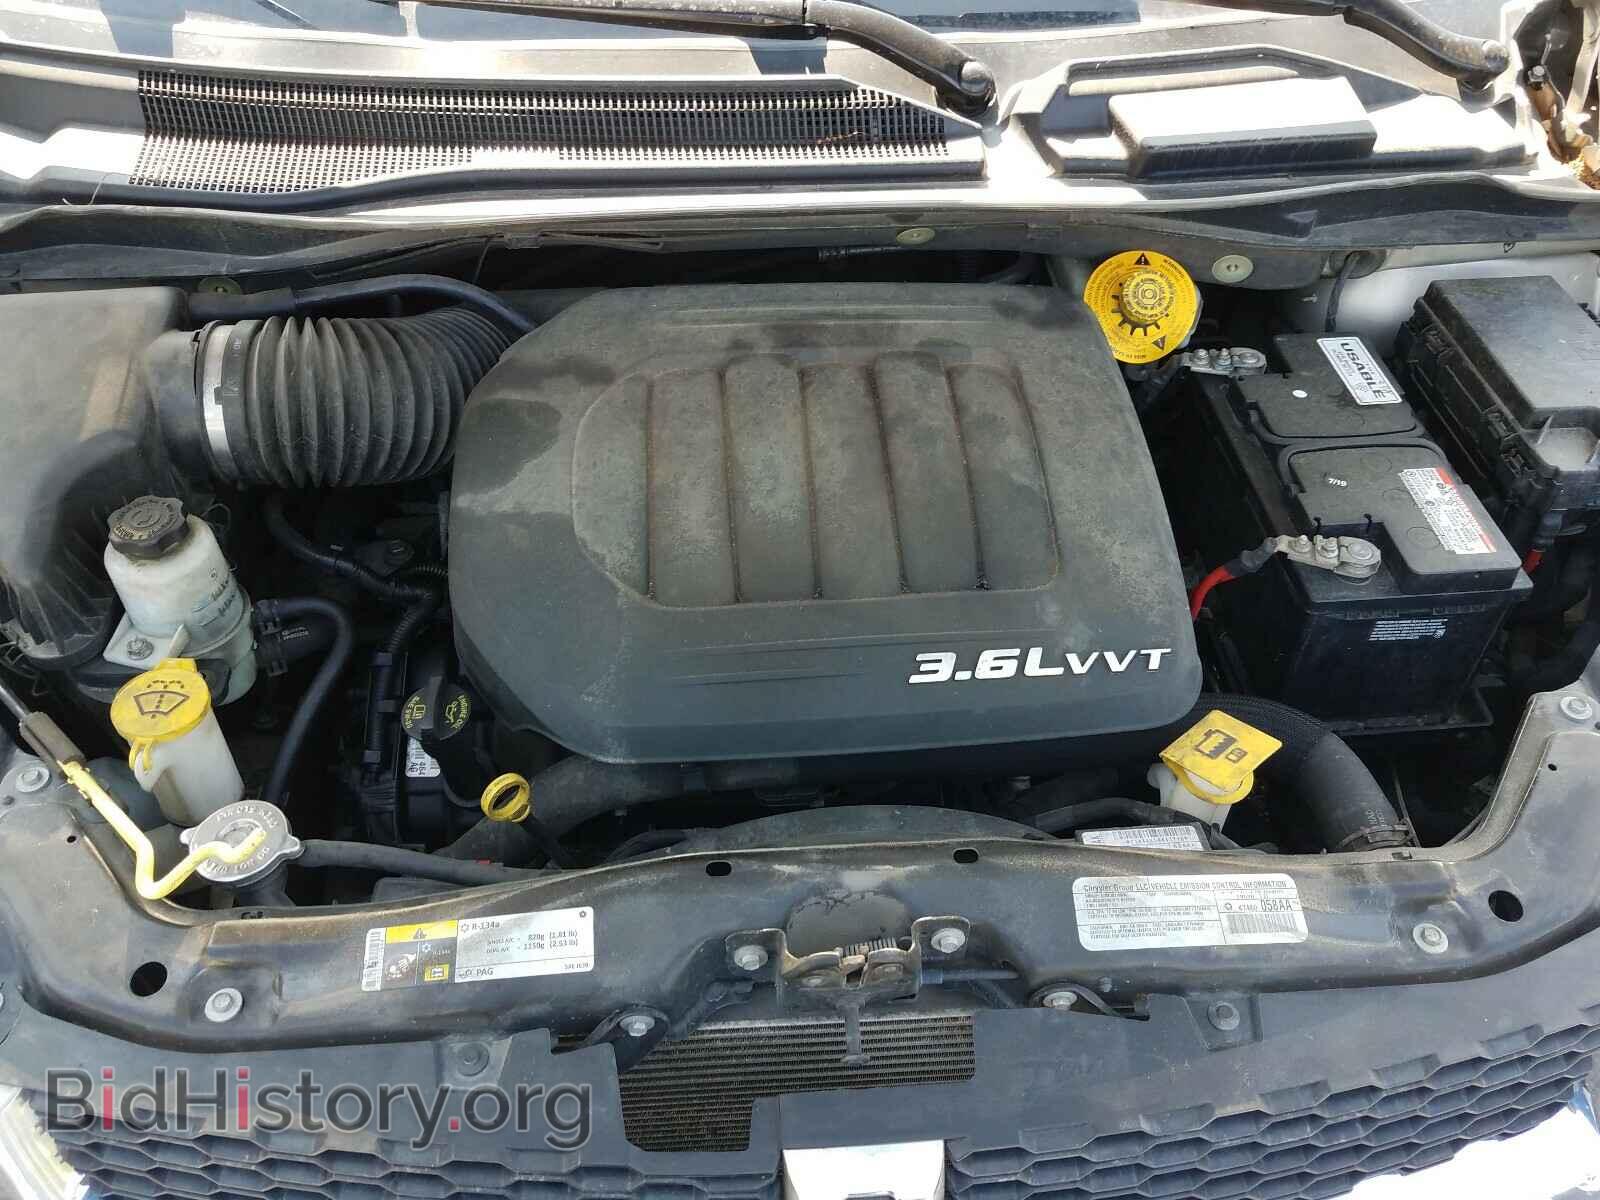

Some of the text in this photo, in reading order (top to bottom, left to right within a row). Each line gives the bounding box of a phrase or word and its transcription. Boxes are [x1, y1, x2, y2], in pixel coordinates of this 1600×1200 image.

[1340, 342, 1387, 399] USABLE
[1328, 477, 1348, 488] 7/19
[1084, 883, 1112, 893] Chrysler
[1113, 883, 1134, 892] Group
[1150, 882, 1177, 891] VEHICLE
[1180, 881, 1210, 890] EMISSION
[1212, 881, 1242, 889] CONTROL
[1243, 879, 1287, 889] INFORMATION
[476, 967, 494, 977] PAG
